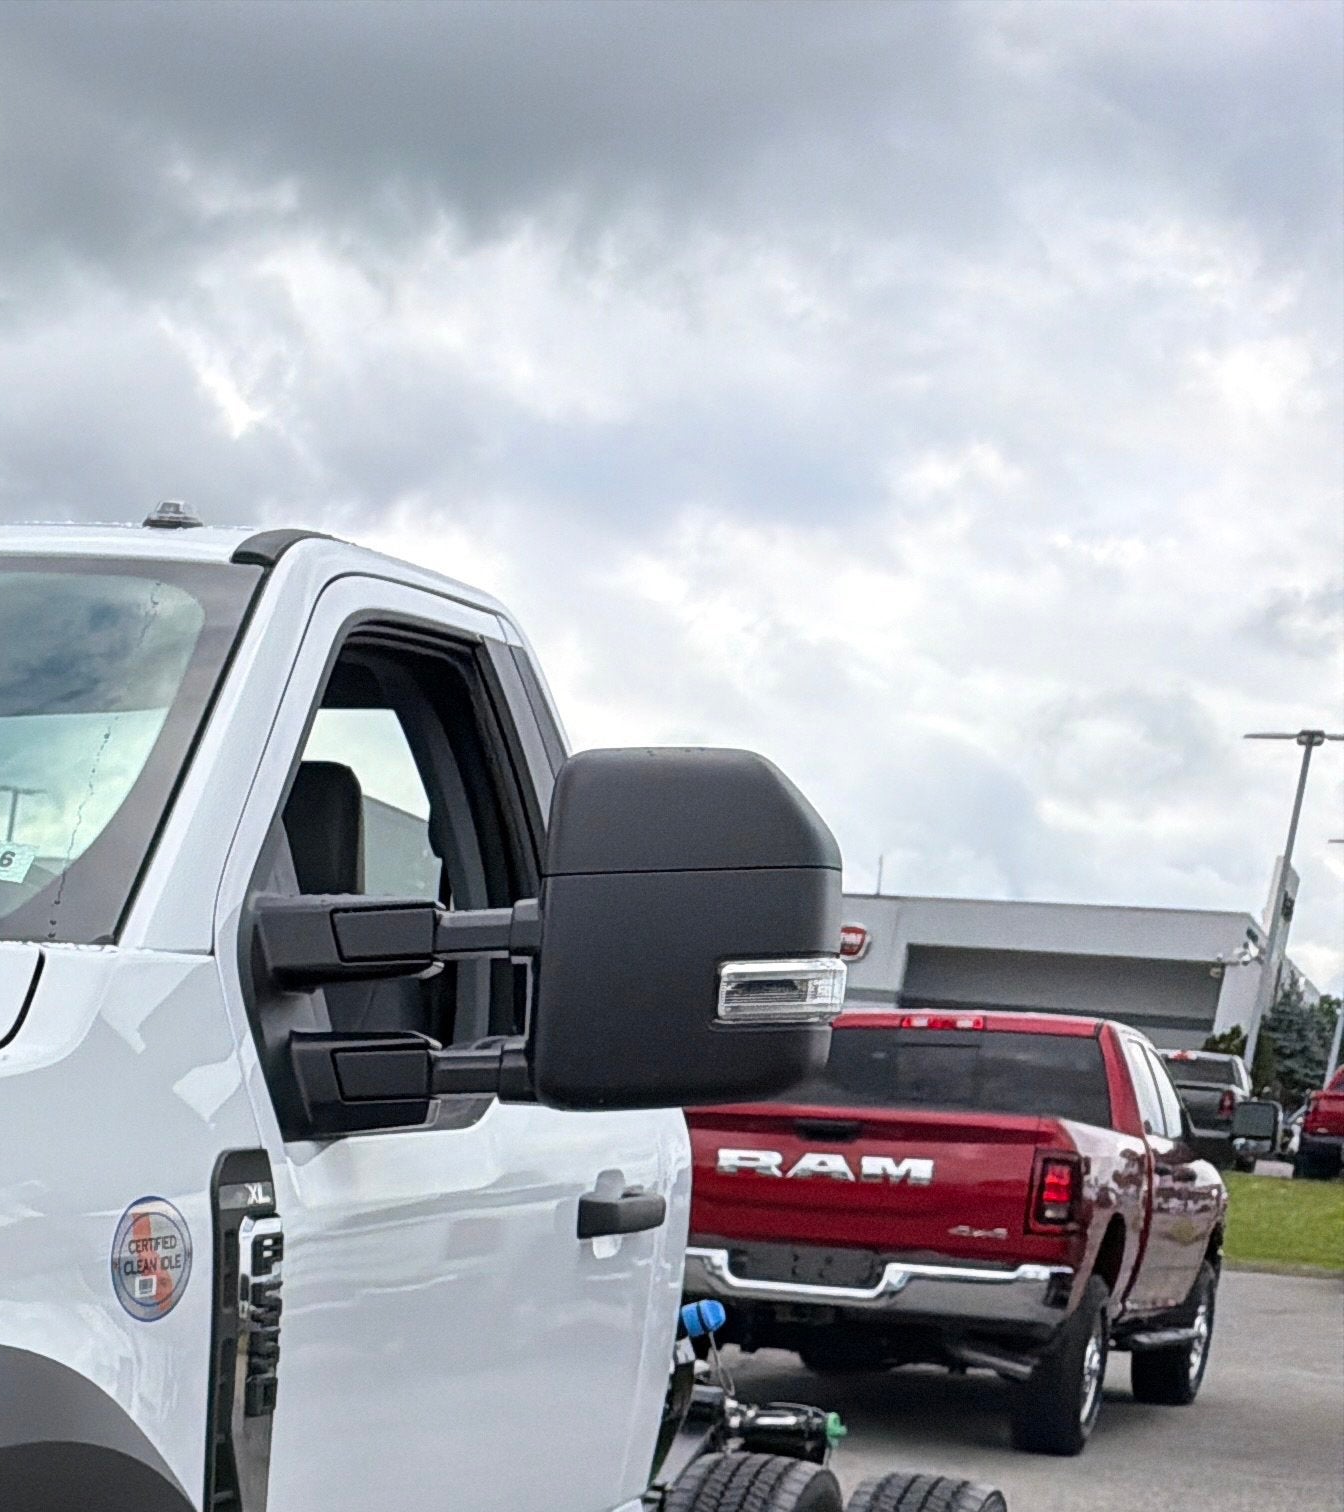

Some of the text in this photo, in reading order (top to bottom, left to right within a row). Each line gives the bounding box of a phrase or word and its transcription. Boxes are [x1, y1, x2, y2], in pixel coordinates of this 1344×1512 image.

[717, 1147, 934, 1186] RAM
[244, 1182, 272, 1204] XL
[123, 1257, 158, 1276] CLEAN
